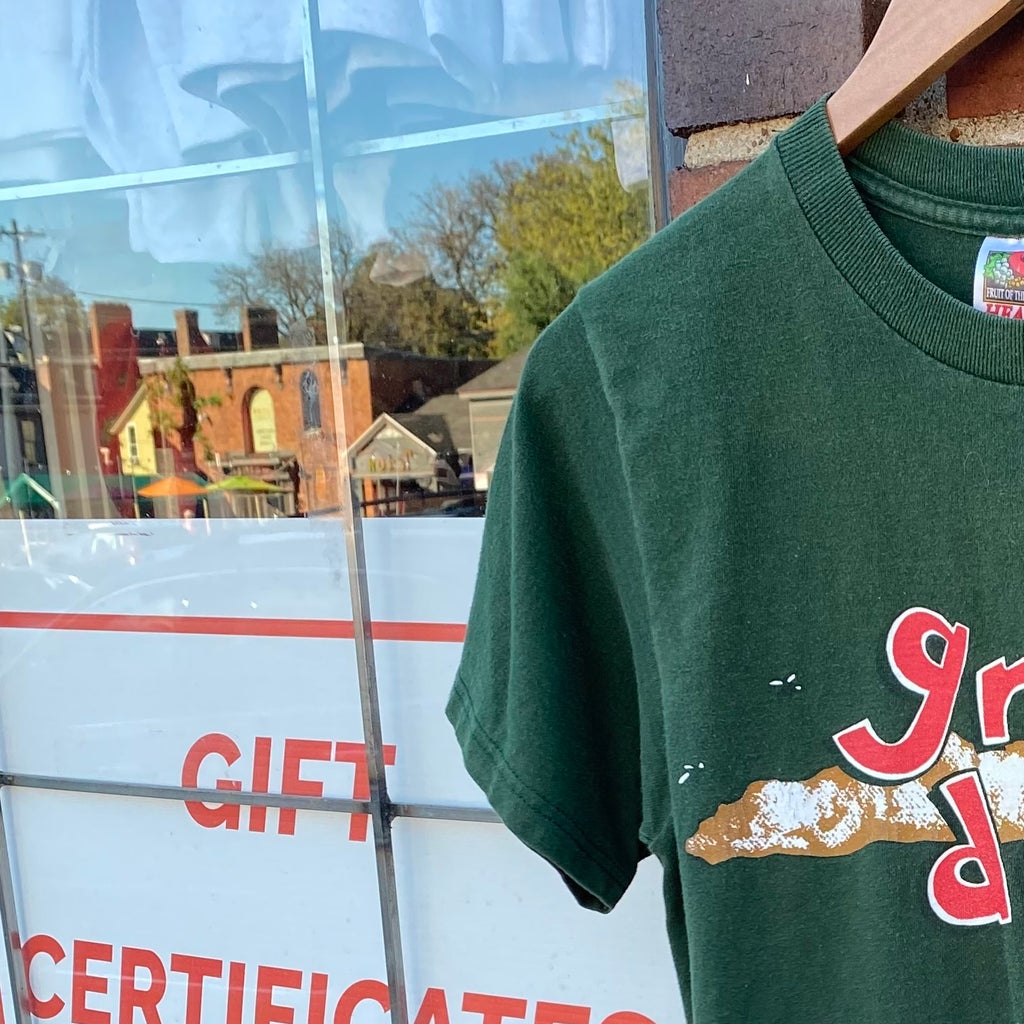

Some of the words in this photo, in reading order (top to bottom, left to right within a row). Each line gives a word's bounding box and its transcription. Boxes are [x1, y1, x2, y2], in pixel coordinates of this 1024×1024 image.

[986, 287, 1004, 299] FRUIT
[1005, 289, 1014, 300] OF
[181, 733, 397, 842] GIFT
